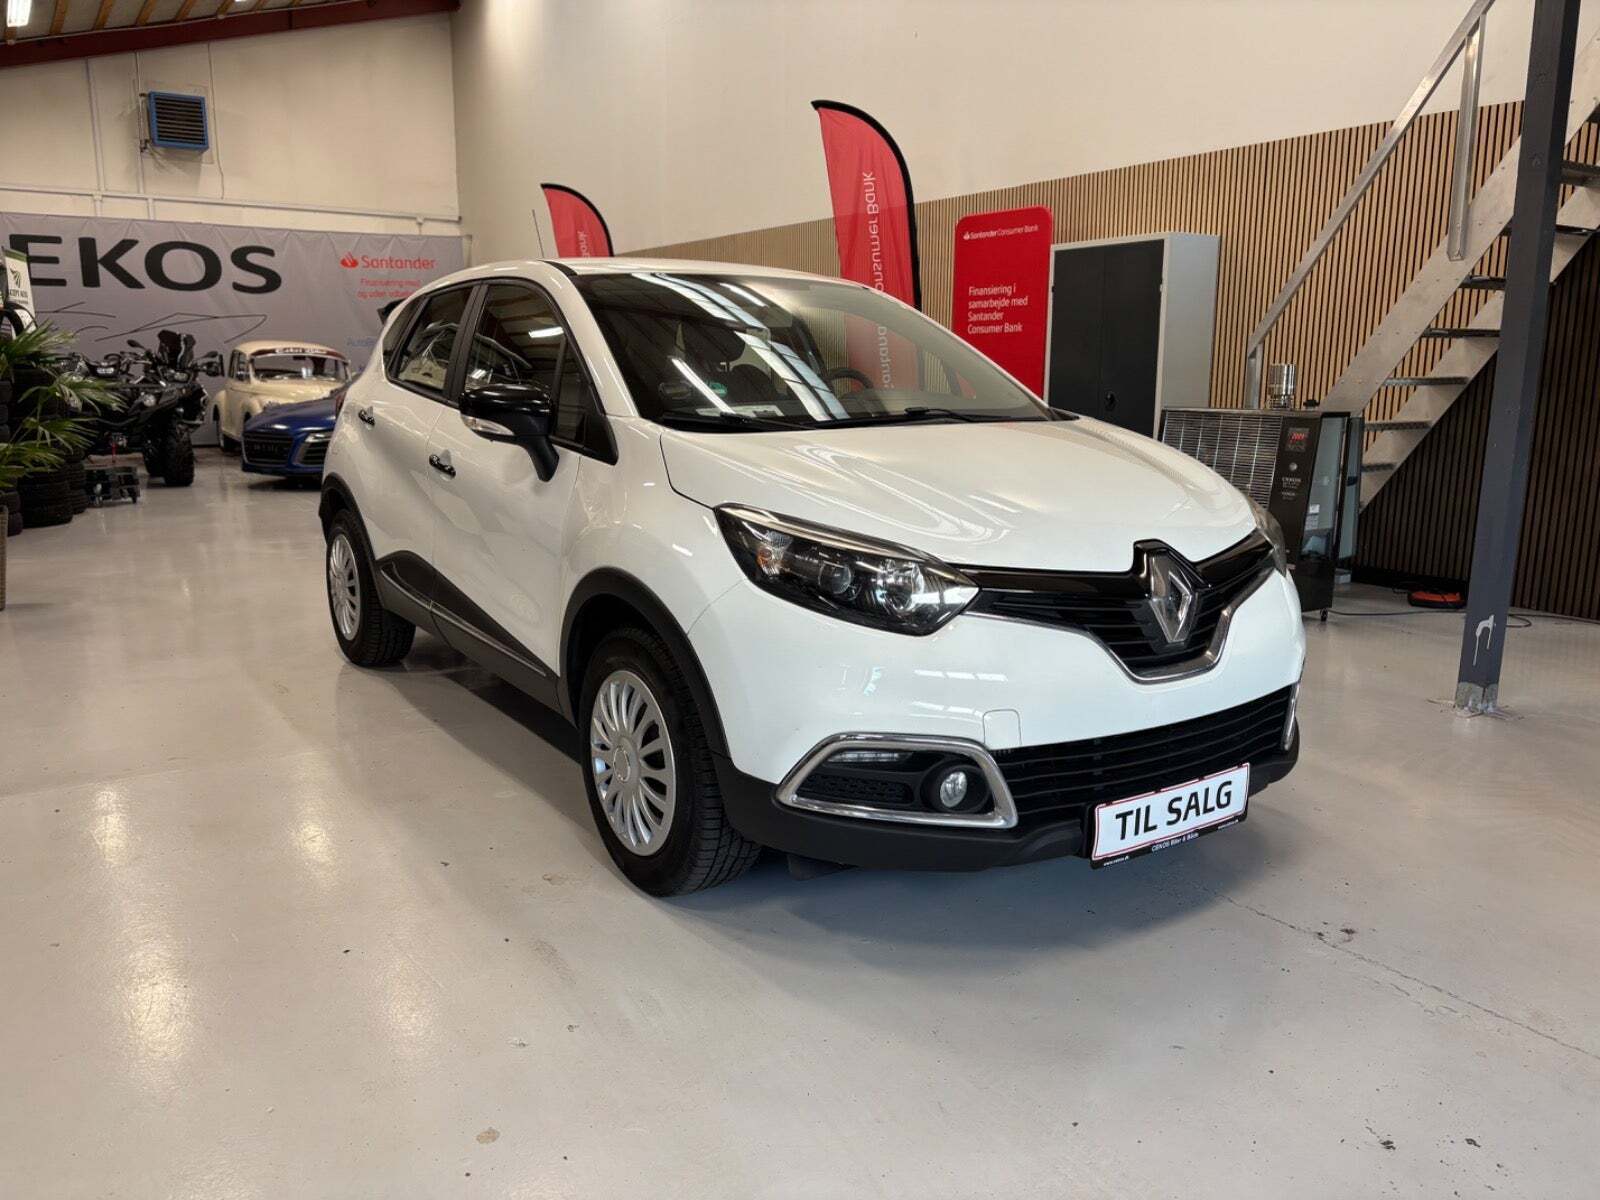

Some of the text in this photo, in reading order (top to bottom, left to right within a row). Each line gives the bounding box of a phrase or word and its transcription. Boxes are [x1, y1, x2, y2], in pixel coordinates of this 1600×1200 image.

[9, 233, 282, 294] EKOS
[361, 255, 436, 269] Santander
[968, 285, 1012, 296] Finansiering
[968, 296, 1028, 310] samarbejde med
[968, 311, 1004, 322] Santander
[968, 322, 1023, 334] Consumer Bank
[1115, 781, 1232, 840] TIL SALG
